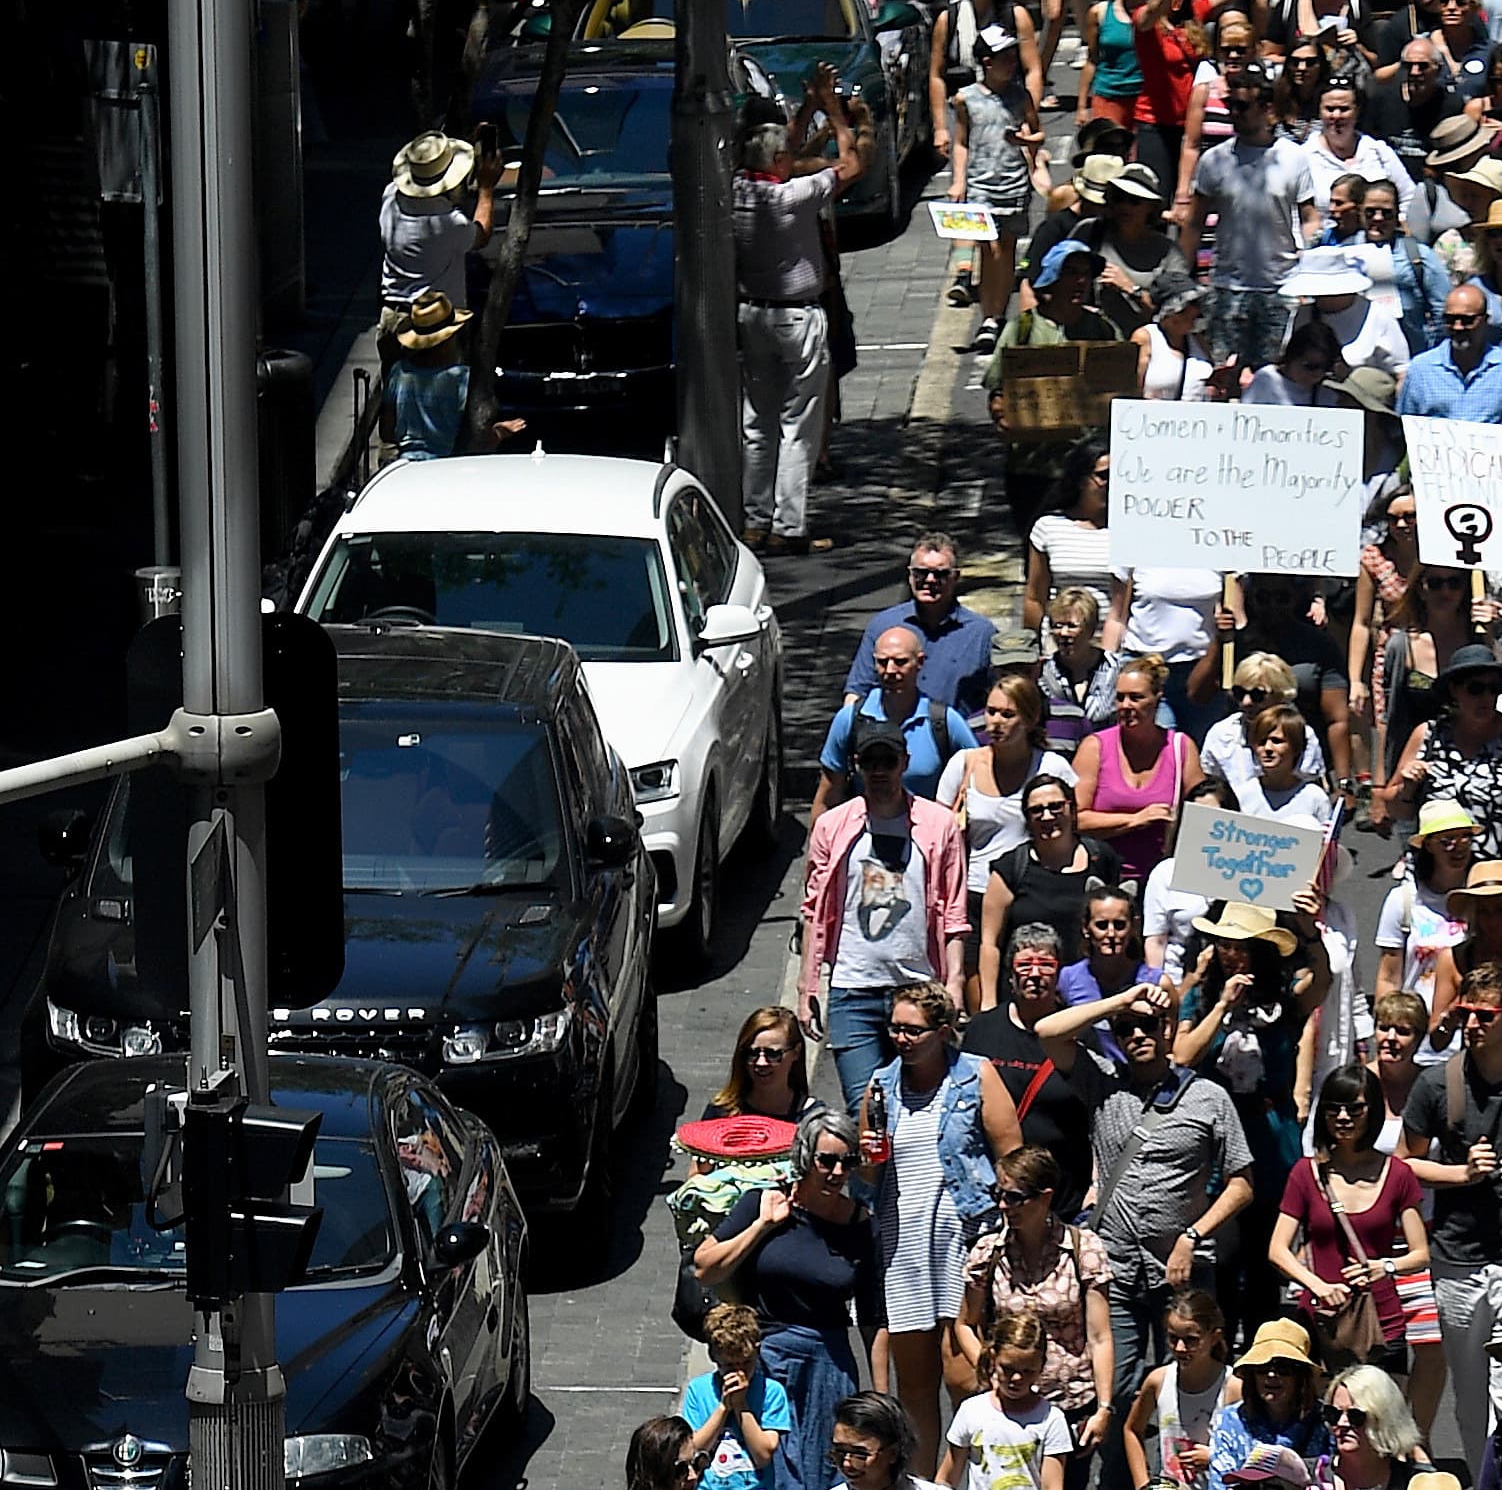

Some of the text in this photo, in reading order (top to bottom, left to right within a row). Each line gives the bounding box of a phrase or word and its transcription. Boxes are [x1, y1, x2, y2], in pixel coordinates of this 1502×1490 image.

[1113, 403, 1209, 441] Women
[1230, 407, 1351, 450] Minorities
[1113, 451, 1359, 508] We are the Majority
[1122, 493, 1205, 521] POWER
[1220, 528, 1253, 549] THE
[1262, 546, 1337, 573] PEOPLE
[1208, 819, 1300, 858] Stronger
[1202, 845, 1296, 880] Together
[312, 1008, 425, 1021] ROVER
